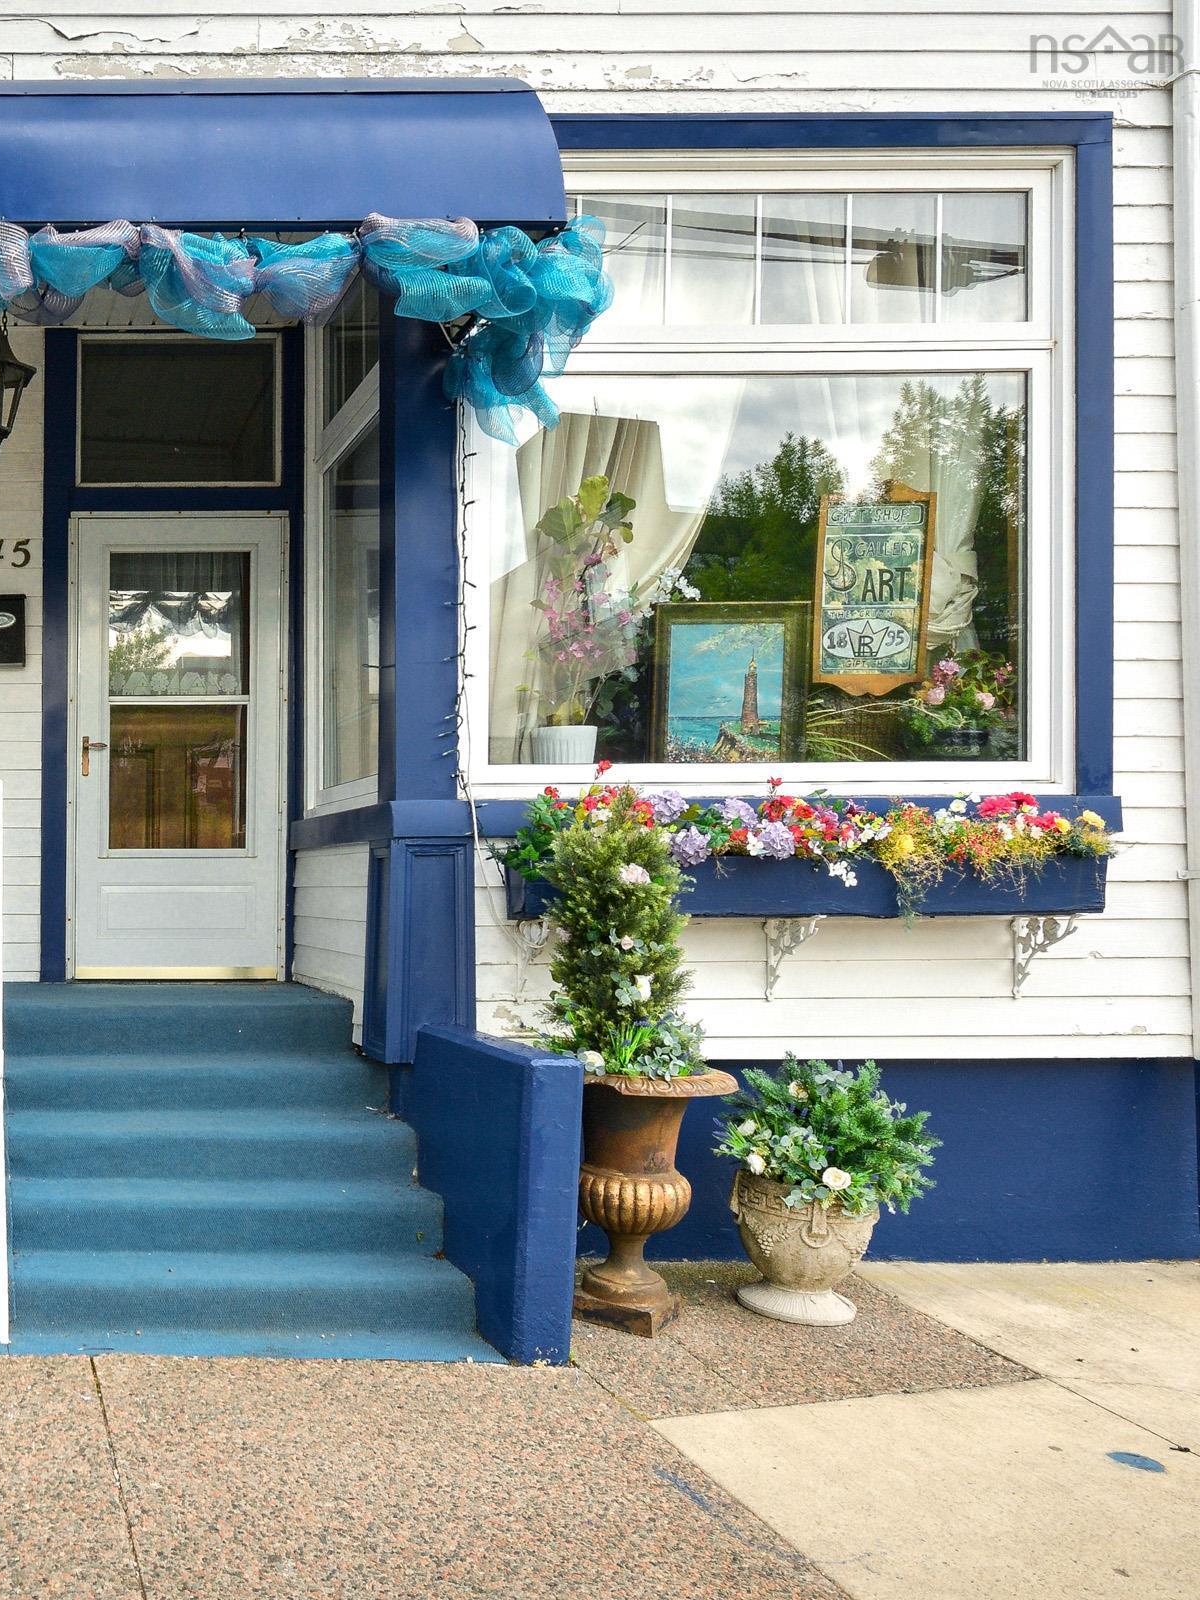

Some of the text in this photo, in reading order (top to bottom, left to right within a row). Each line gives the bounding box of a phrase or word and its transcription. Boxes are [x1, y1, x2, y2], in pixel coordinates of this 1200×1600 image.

[872, 508, 909, 522] SHOP
[855, 542, 914, 558] GALLERY
[861, 567, 913, 602] ART
[827, 630, 848, 650] 18
[885, 629, 905, 647] 95
